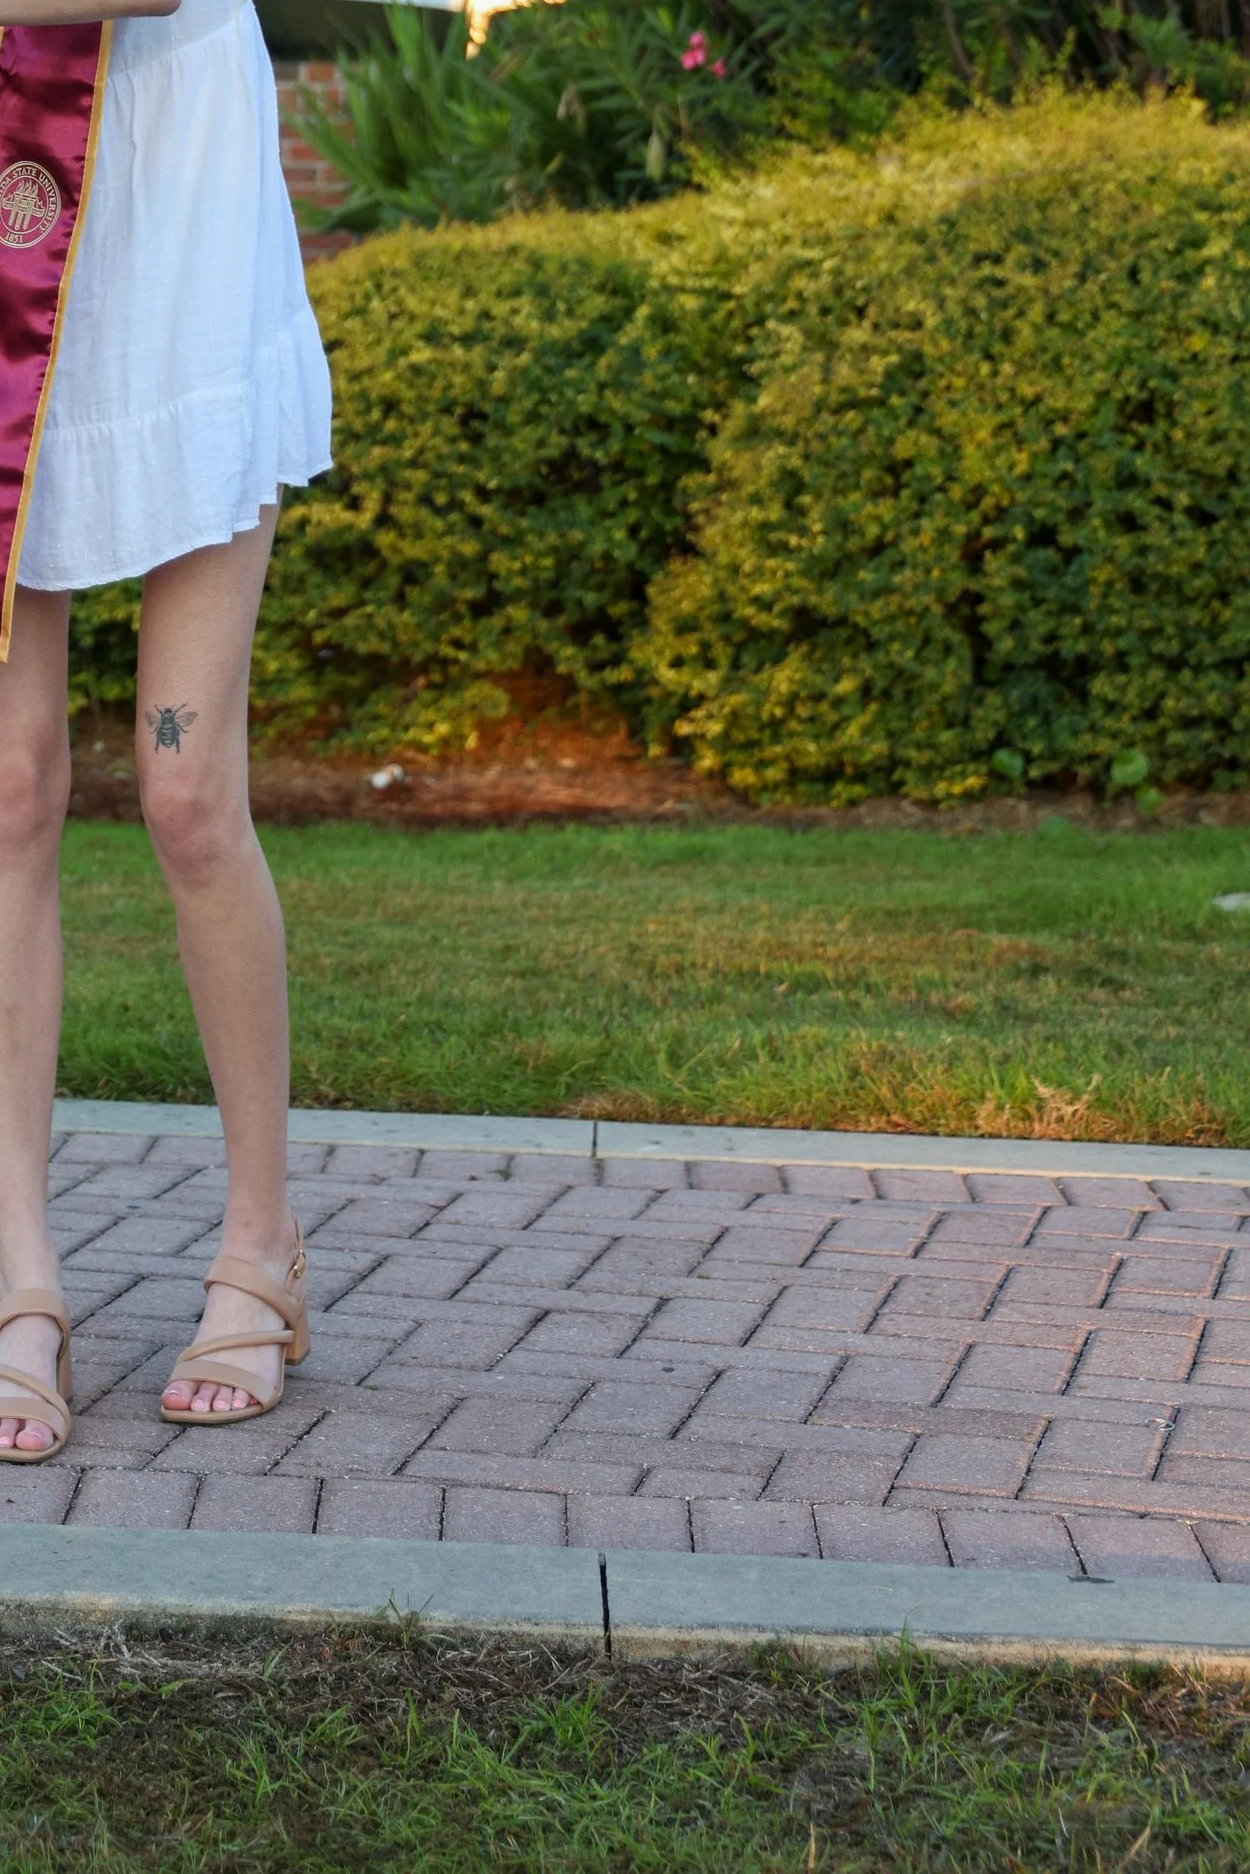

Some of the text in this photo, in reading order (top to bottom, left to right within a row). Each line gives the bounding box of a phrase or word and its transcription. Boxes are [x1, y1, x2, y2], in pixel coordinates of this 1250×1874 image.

[12, 167, 37, 179] STATE
[39, 173, 56, 233] UNIVERSITY
[5, 232, 23, 243] 1851
